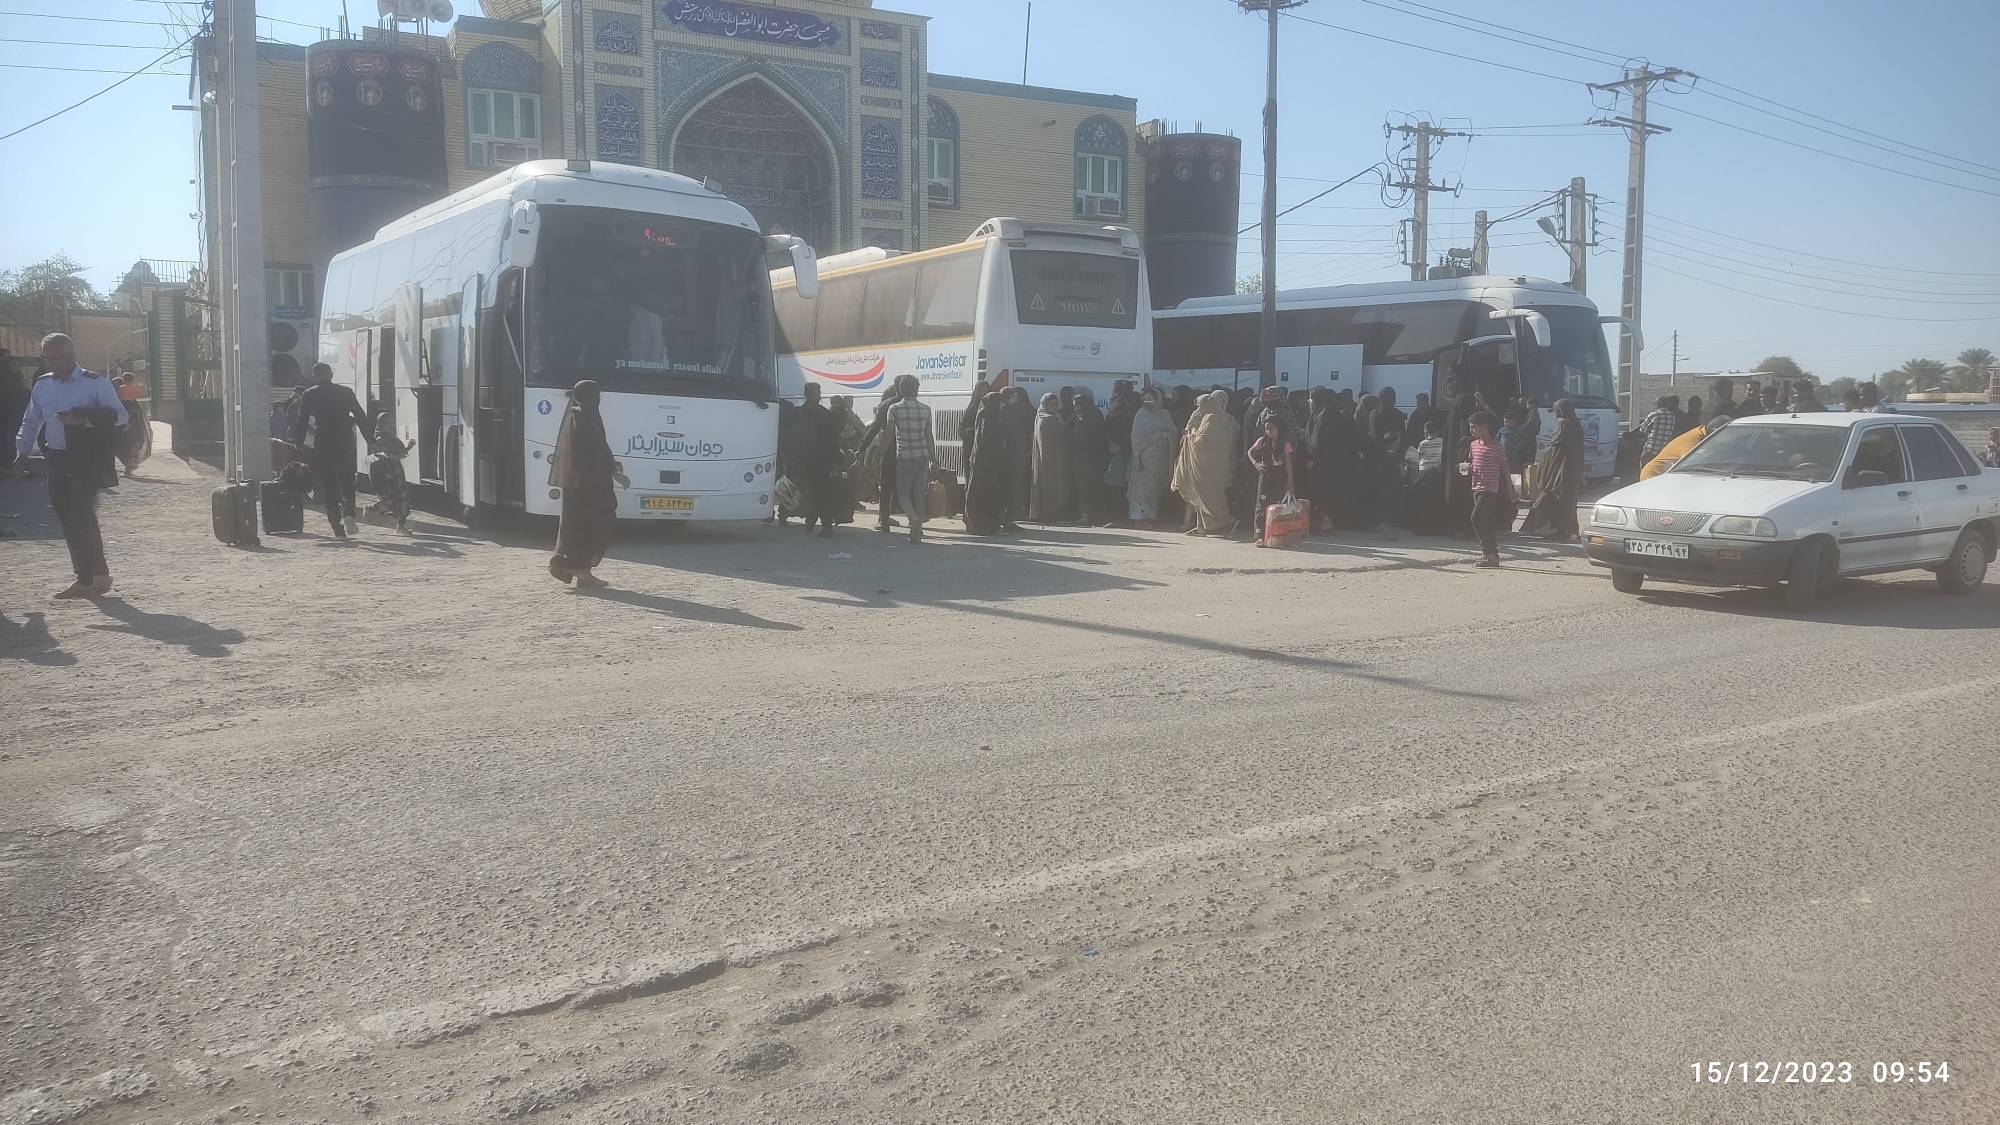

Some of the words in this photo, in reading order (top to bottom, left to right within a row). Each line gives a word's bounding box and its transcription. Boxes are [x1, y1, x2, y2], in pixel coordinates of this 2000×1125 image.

[767, 20, 799, 39] حضرت
[794, 24, 831, 42] مسجد
[625, 433, 657, 455] ایثار
[656, 440, 685, 457] سیر
[685, 439, 724, 458] جوان
